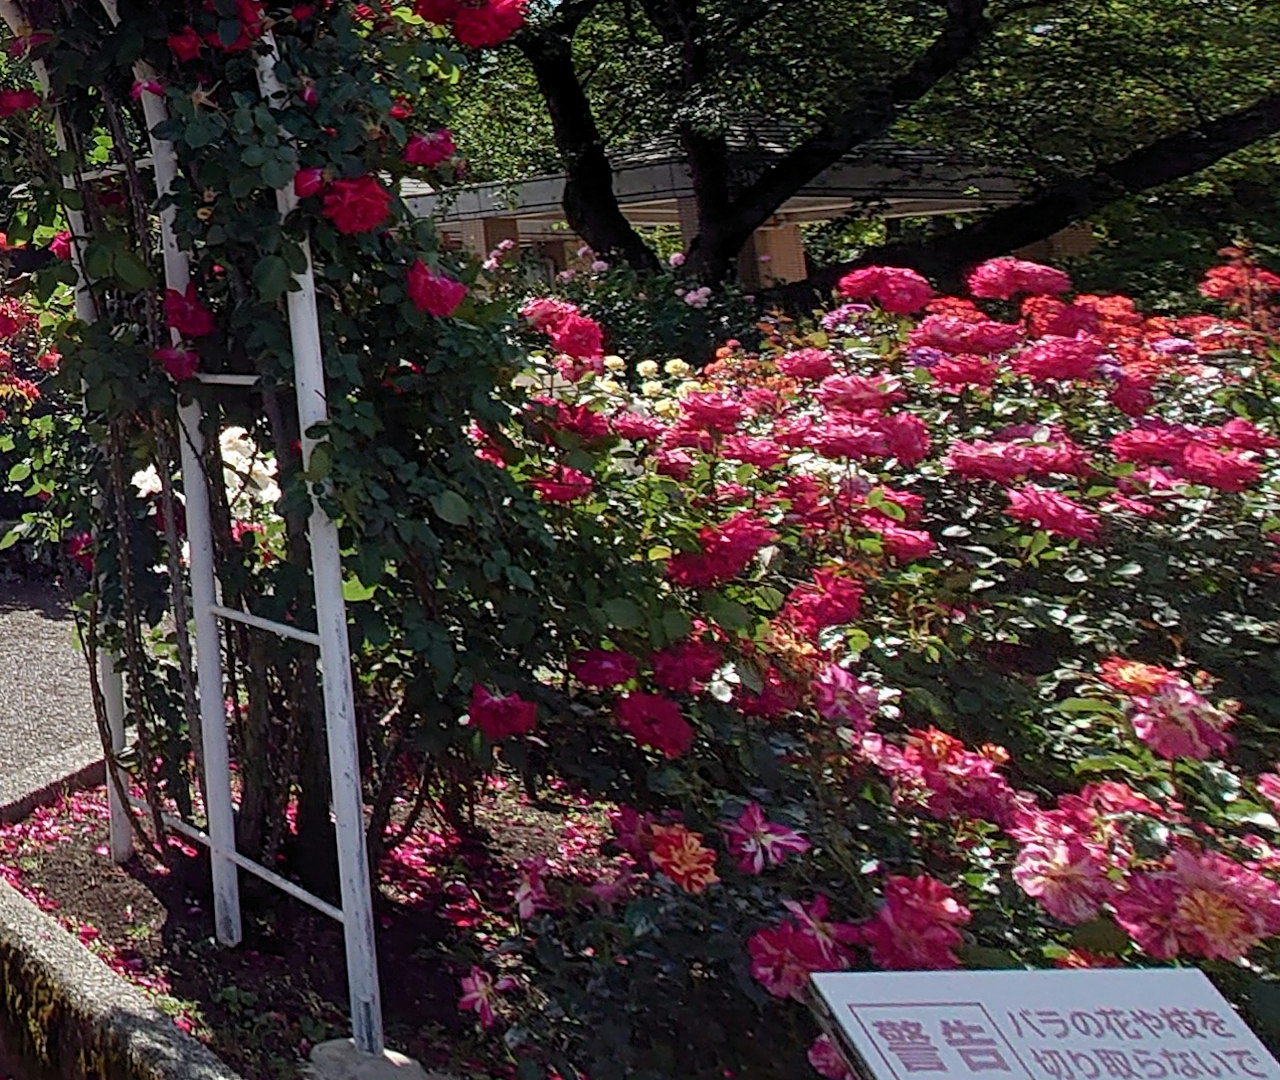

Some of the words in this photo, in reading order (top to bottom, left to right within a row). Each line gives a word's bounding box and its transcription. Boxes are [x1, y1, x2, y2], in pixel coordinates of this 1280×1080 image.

[1007, 1007, 1235, 1040] バラの花や枝を
[872, 1019, 1012, 1073] 警告
[1030, 1047, 1268, 1080] 切り取らないで
